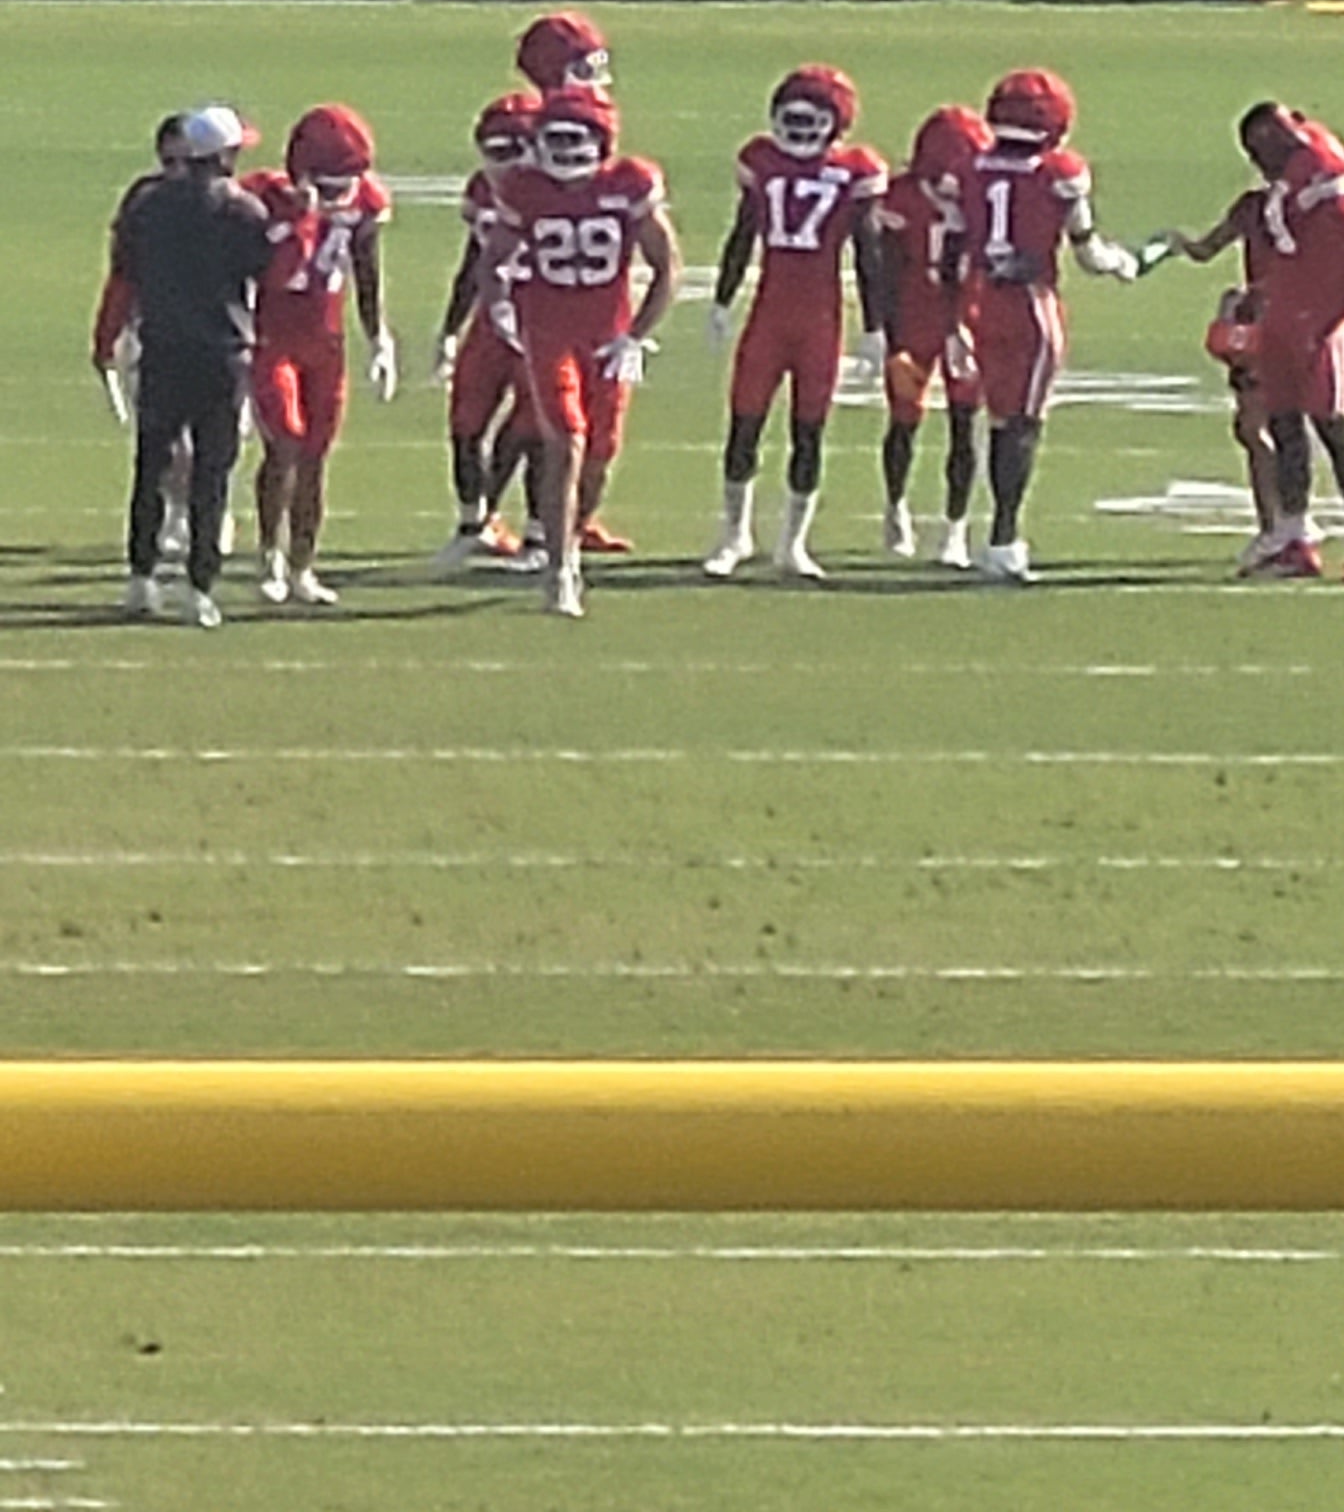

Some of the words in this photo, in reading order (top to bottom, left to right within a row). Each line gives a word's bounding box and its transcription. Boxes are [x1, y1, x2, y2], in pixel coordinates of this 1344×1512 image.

[765, 176, 838, 249] 17
[984, 179, 1014, 258] 1
[534, 216, 622, 287] 29
